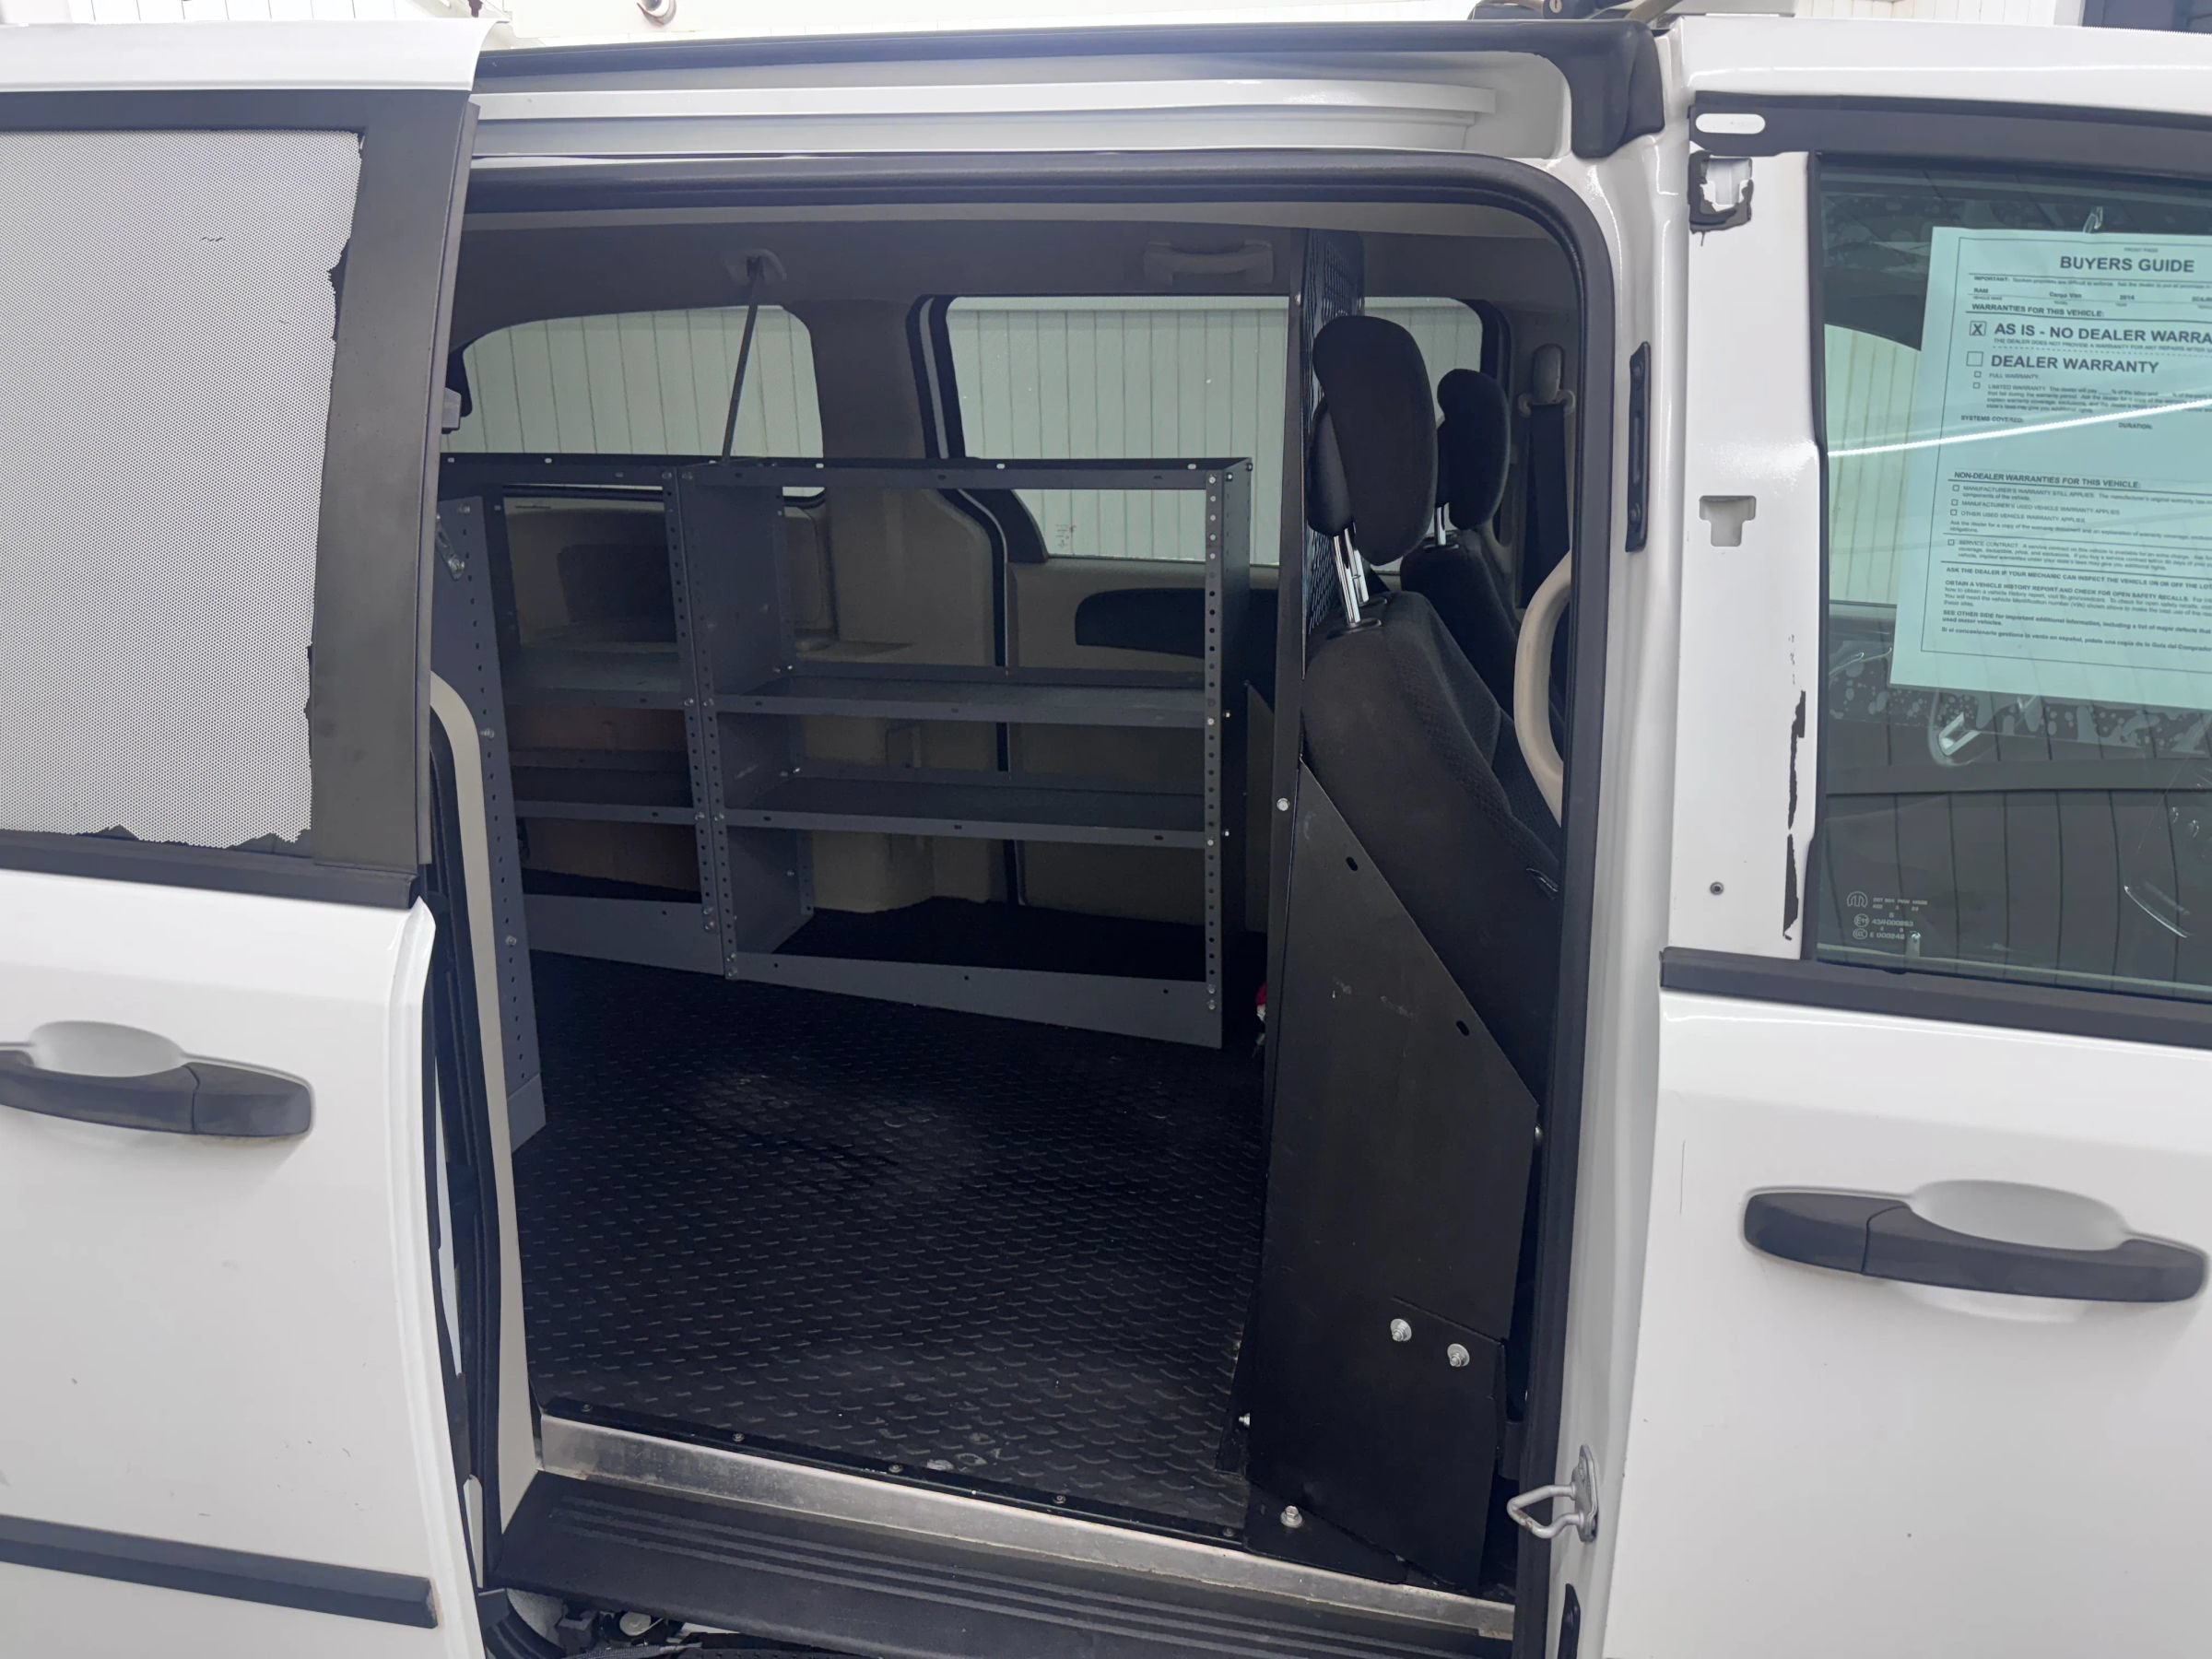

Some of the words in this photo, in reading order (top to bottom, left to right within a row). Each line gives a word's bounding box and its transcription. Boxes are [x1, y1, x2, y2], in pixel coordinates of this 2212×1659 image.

[2060, 255, 2133, 272] BUYERS
[2137, 258, 2195, 273] GUIDE
[1971, 303, 2026, 312] WARRANTIES
[2027, 306, 2044, 314] FOR
[2046, 307, 2065, 315] THIS
[2066, 309, 2104, 317] VEHICLE:
[1994, 323, 2017, 335] AS
[2020, 324, 2035, 336] IS
[2050, 326, 2074, 339] NO
[2078, 327, 2146, 341] DEALER
[1991, 354, 2058, 370] DEALER
[2063, 358, 2159, 374] WARRANTY
[1954, 471, 2005, 481] NON-DEALER
[2006, 475, 2060, 484] WARRANTIES
[2062, 477, 2080, 486] FOR
[2082, 478, 2100, 487] THIS
[2102, 479, 2141, 488] VEHICLE:
